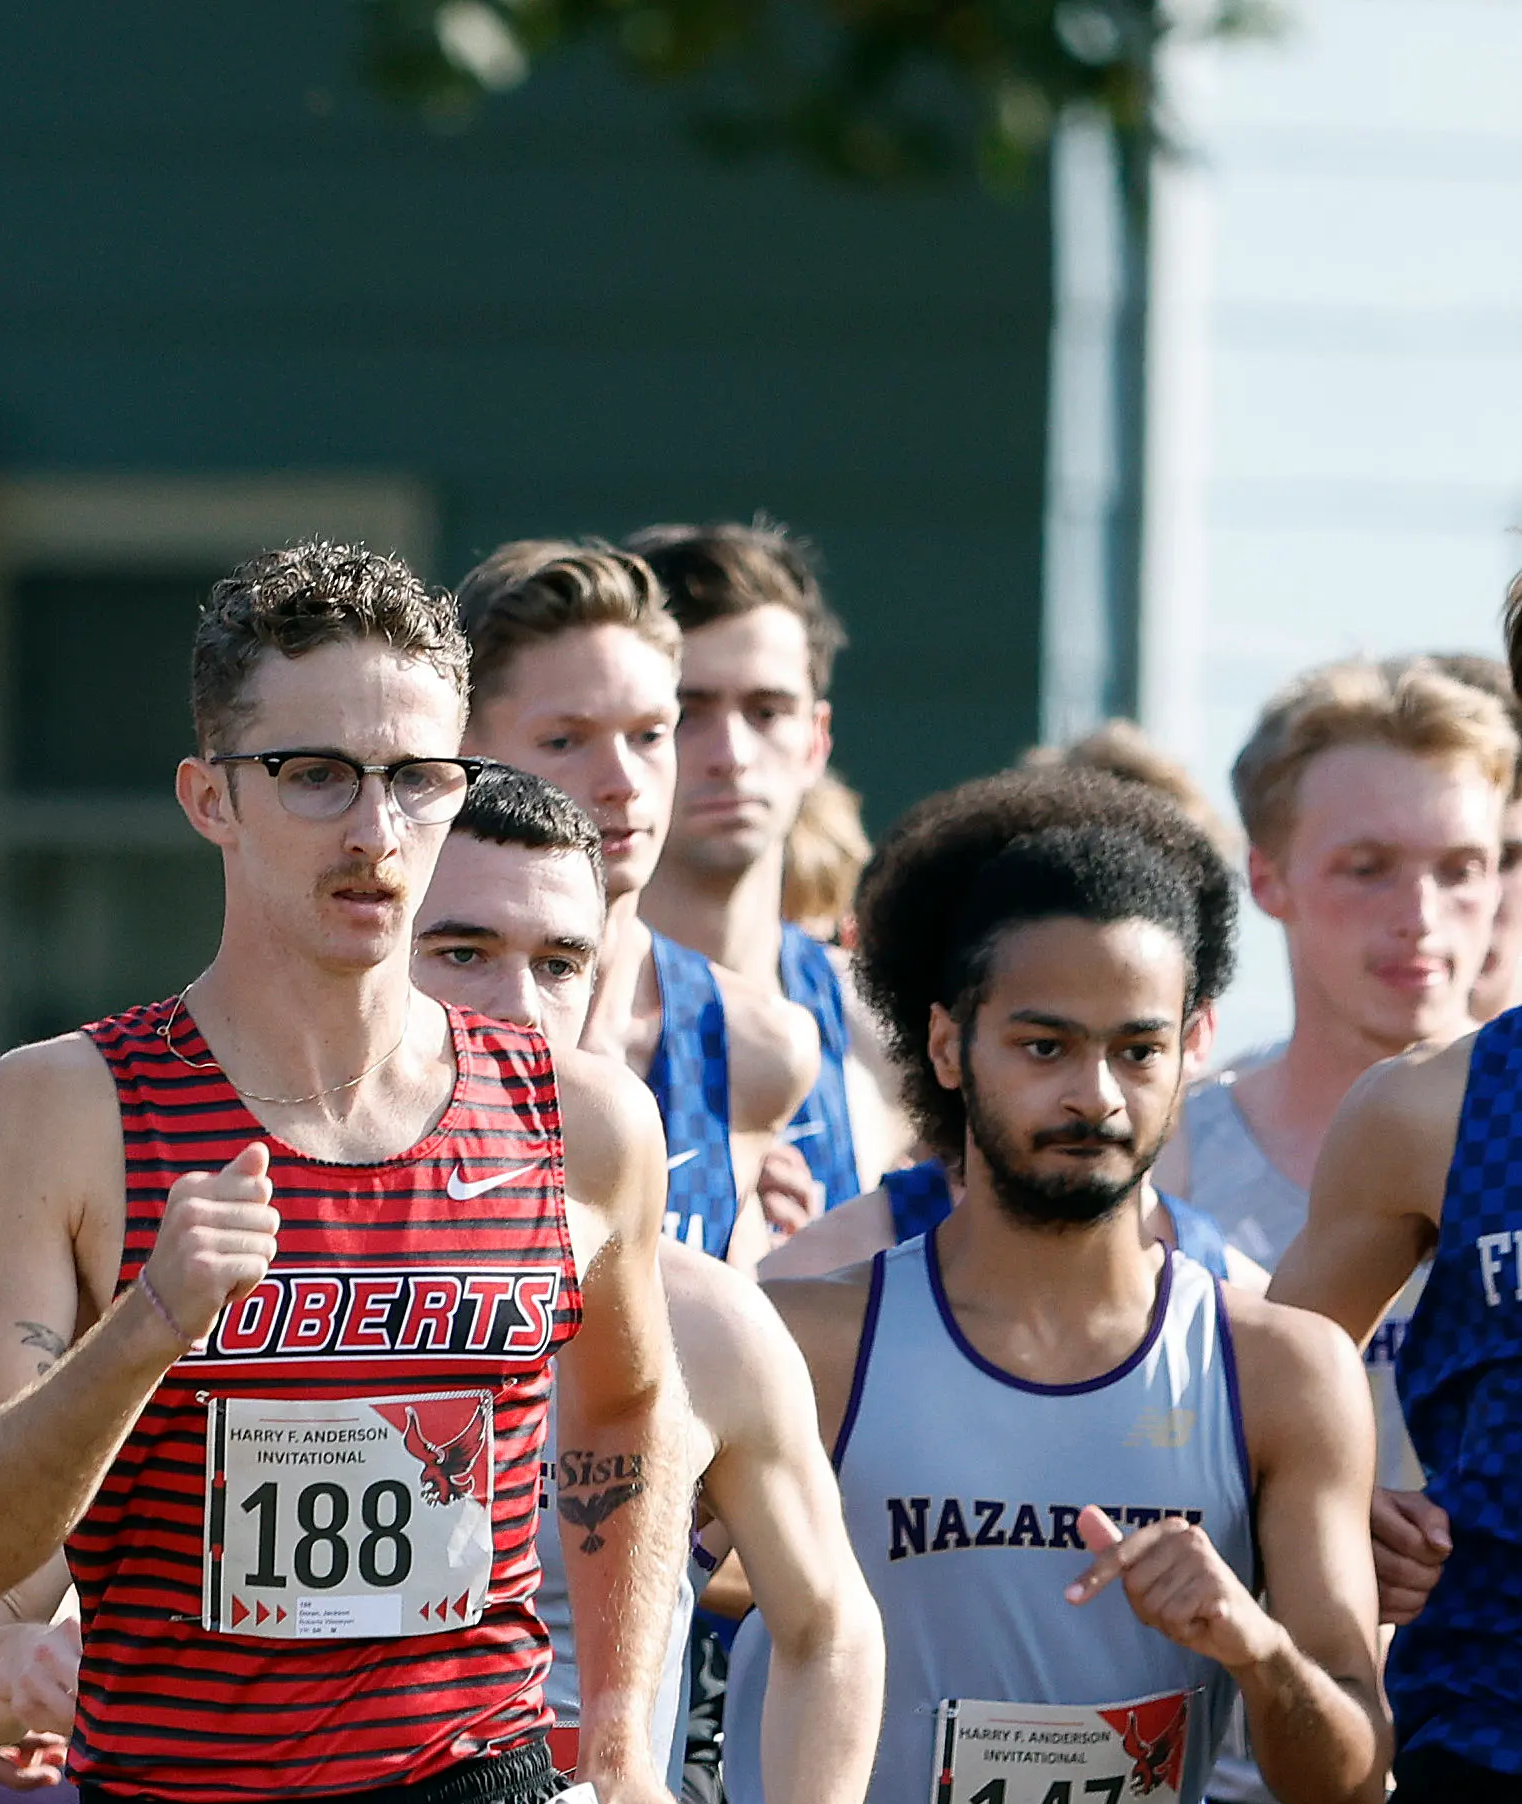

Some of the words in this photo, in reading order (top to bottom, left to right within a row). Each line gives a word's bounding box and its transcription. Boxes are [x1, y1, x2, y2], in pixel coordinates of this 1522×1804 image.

[191, 1276, 555, 1355] OBERTS
[230, 1427, 283, 1443] HARRY
[288, 1429, 298, 1444] F.
[303, 1427, 388, 1443] ANDERSON
[257, 1451, 367, 1466] INVITATIONAL
[241, 1479, 413, 1589] 188
[958, 1727, 1010, 1742] HARRY
[1014, 1730, 1025, 1743] F.
[1029, 1730, 1112, 1745] ANDERSON
[983, 1749, 1088, 1764] INVITATIONAL
